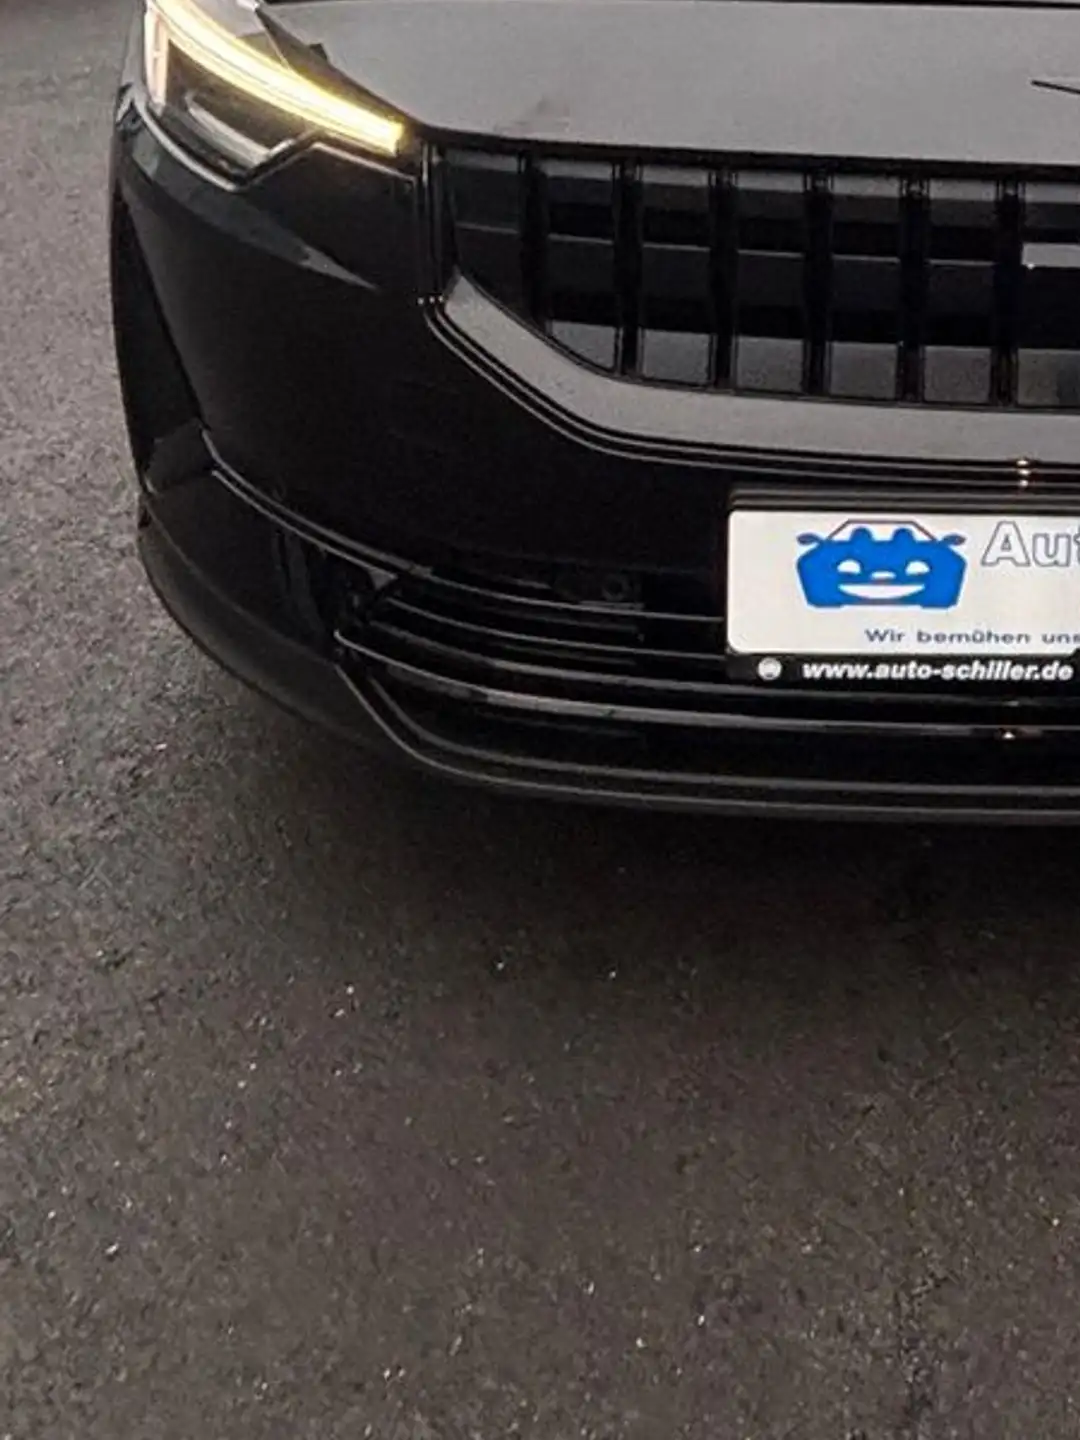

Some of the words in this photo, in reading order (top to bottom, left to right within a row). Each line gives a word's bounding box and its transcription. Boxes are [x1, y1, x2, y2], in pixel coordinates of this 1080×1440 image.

[864, 628, 905, 644] Wir
[917, 629, 1031, 644] bemühen
[803, 661, 1073, 681] www.auto-schiller.de
